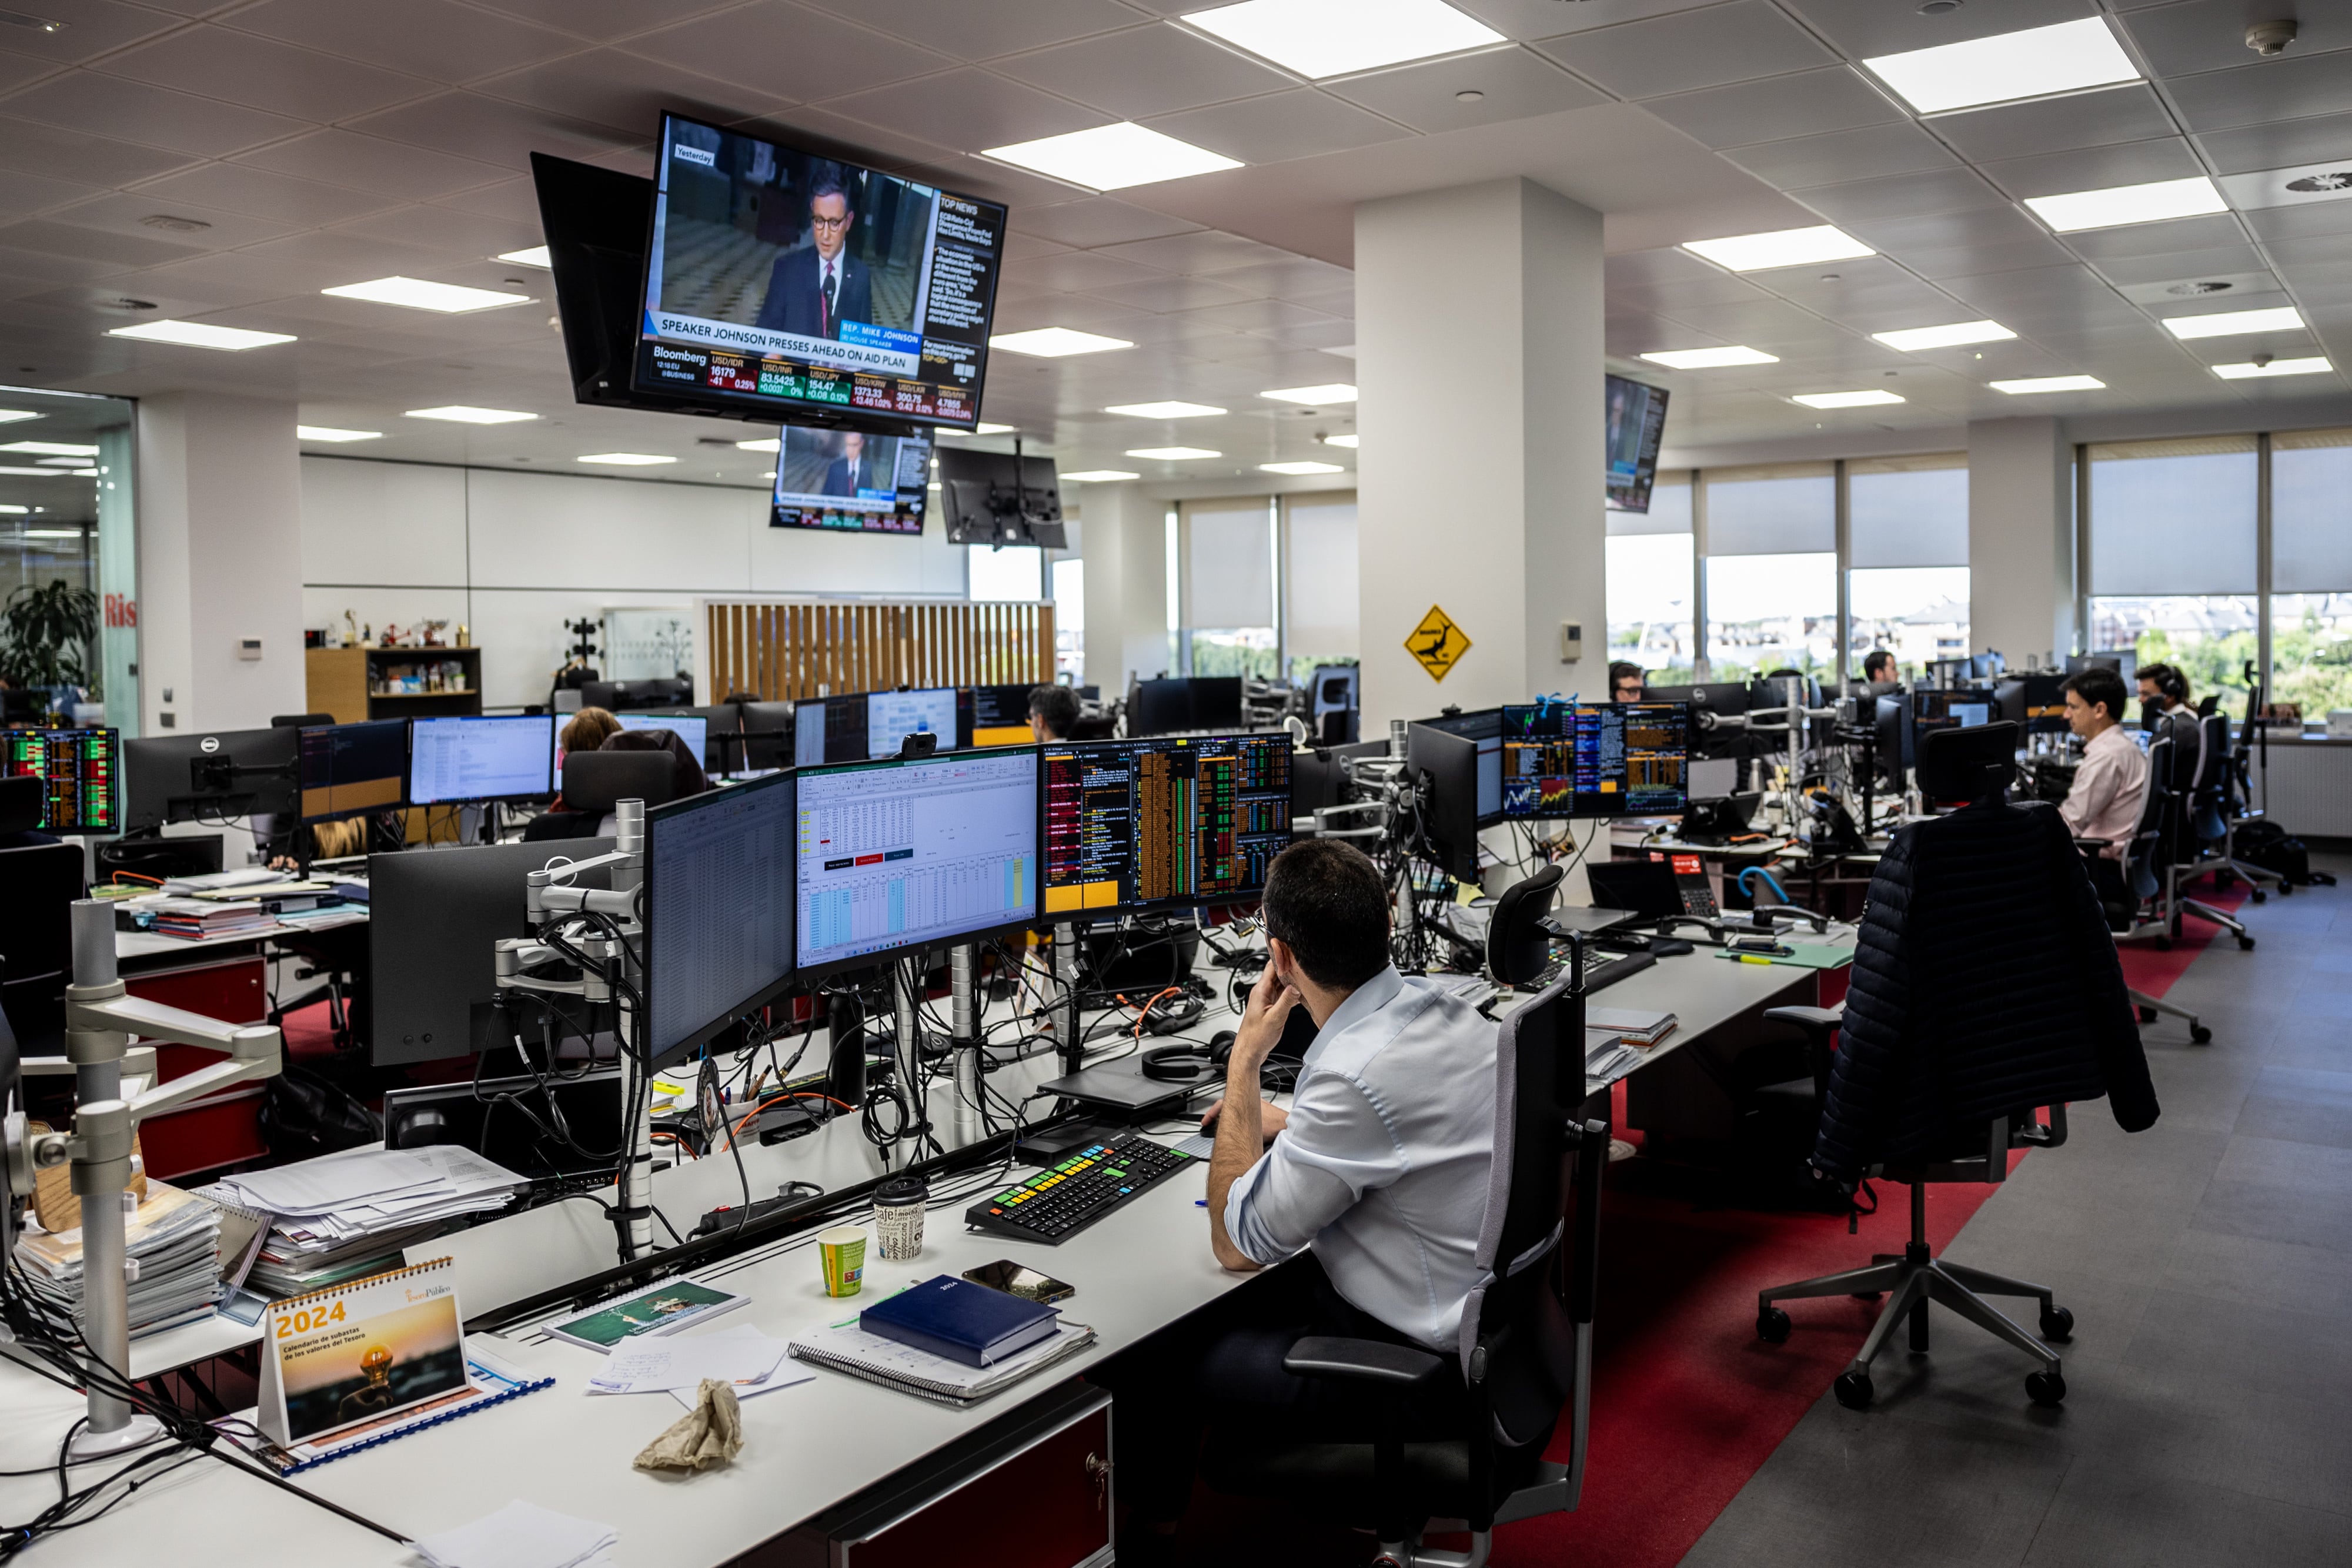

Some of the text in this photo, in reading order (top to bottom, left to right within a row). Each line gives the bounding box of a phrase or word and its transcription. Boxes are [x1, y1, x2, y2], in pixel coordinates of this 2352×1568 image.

[677, 148, 711, 165] Yesterday
[941, 197, 978, 215] TOP NEWS
[948, 251, 974, 262] economic
[950, 266, 972, 276] moment
[933, 270, 978, 286] different from the
[948, 296, 983, 309] consequence
[950, 304, 971, 315] reaction
[928, 307, 984, 325] monetary policy might
[843, 323, 918, 344] REP. MIKE JOHNSON
[662, 319, 906, 367] SPEAKER JOHNSON PRESSES AHEAD ON AID PLAN
[850, 336, 867, 345] HOUSE
[870, 338, 892, 348] SPEAKER
[653, 346, 707, 366] Bloomberg
[946, 345, 975, 355] information
[712, 356, 744, 367] USD/IDR
[922, 354, 934, 362] TOP
[711, 366, 736, 377] 16179
[763, 363, 793, 374] USD/INR
[662, 370, 695, 381] @BUSINESS
[761, 373, 795, 386] 83.5425
[810, 370, 840, 381] USD/JPY
[710, 377, 755, 390] -41 0.25%
[808, 380, 835, 391] 154.47
[855, 377, 887, 387] USD/KRW
[760, 385, 803, 397] +0.0037 0%
[854, 386, 883, 398] 1373.33
[897, 383, 926, 394] USD/LKR
[830, 391, 848, 402] 0.12%
[896, 392, 922, 403] 300.75
[276, 1300, 346, 1339] 2024
[283, 1338, 319, 1353] Calendario
[330, 1326, 360, 1340] subastas
[285, 1332, 366, 1361] de los valores del Tesoro
